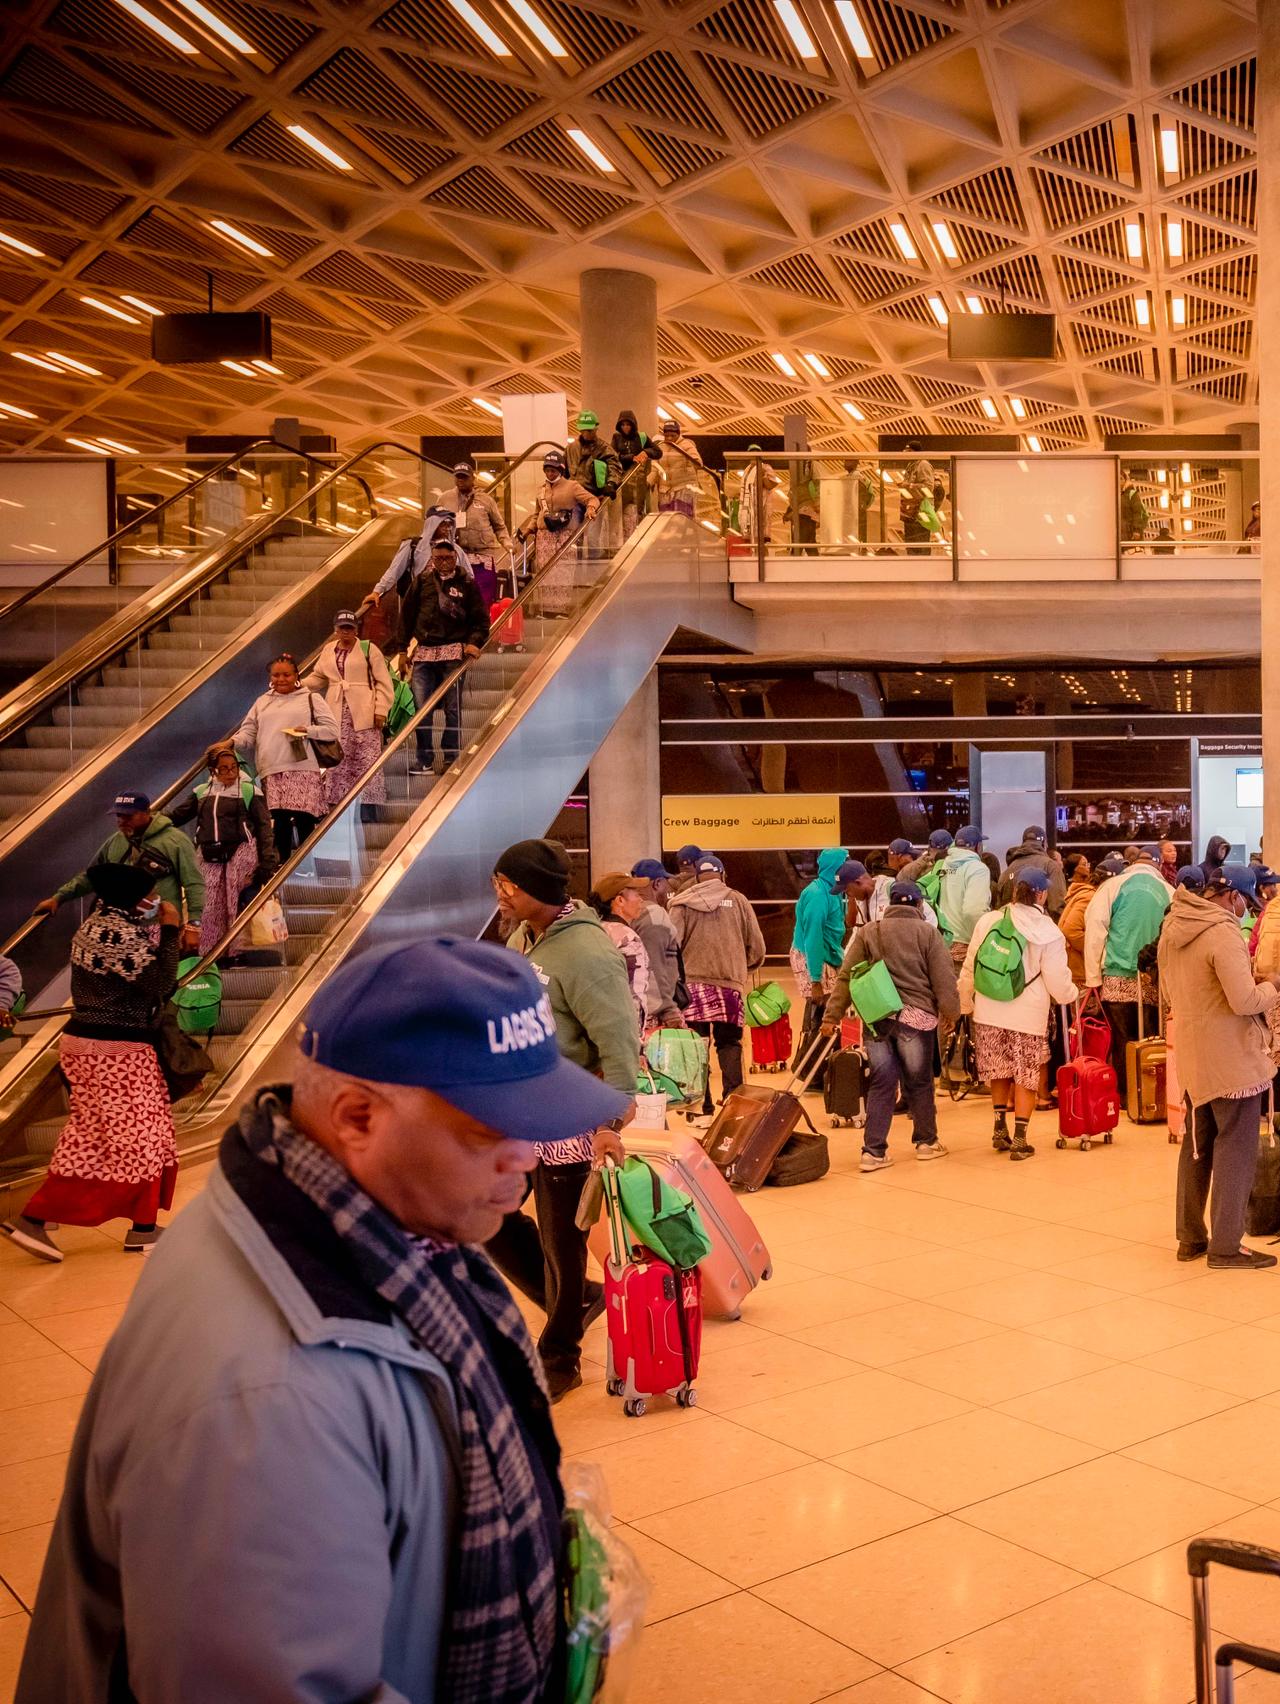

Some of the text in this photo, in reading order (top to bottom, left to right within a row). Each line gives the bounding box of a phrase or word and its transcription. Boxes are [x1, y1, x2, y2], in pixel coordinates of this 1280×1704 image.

[663, 817, 740, 827] Crew Baggage
[752, 816, 836, 827] أمتعة أطقم الطائرات
